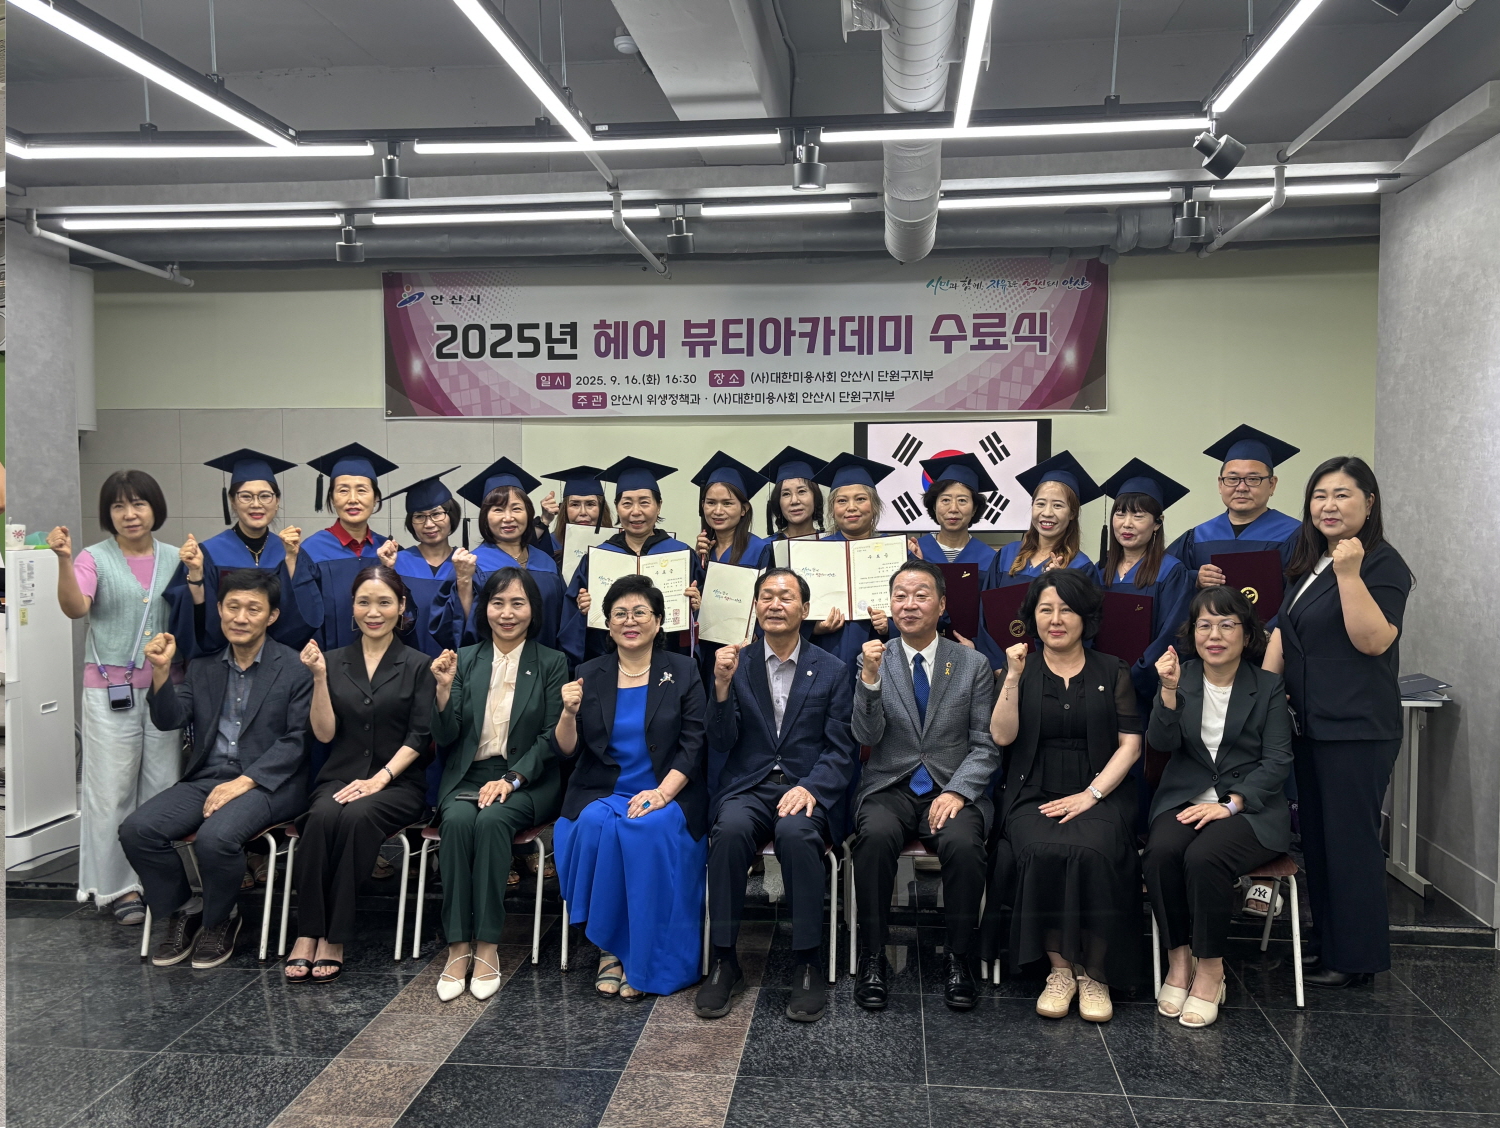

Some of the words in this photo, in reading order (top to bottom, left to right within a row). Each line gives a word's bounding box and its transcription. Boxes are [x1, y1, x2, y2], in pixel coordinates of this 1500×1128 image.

[1062, 276, 1092, 290] 안산
[430, 294, 481, 305] 안산시
[435, 321, 578, 361] 2025년
[593, 319, 666, 359] 헤어
[681, 315, 913, 358] 뷰티아카데미
[929, 311, 1049, 354] 수료식
[540, 375, 567, 386] 일시
[575, 375, 607, 386] 2025.
[610, 375, 621, 385] 9.
[624, 374, 661, 387] 16.(화)
[665, 374, 697, 385] 16:30
[713, 372, 740, 385] 장소
[750, 371, 837, 385] (사)대한미용사회
[840, 370, 874, 383] 안산시
[877, 369, 935, 382] 단원구지부
[577, 394, 603, 407] 주관
[610, 394, 644, 406] 안산시
[713, 391, 799, 406] (사)대한미용사회
[802, 391, 836, 404] 안산시
[839, 390, 896, 404] 단원구지부
